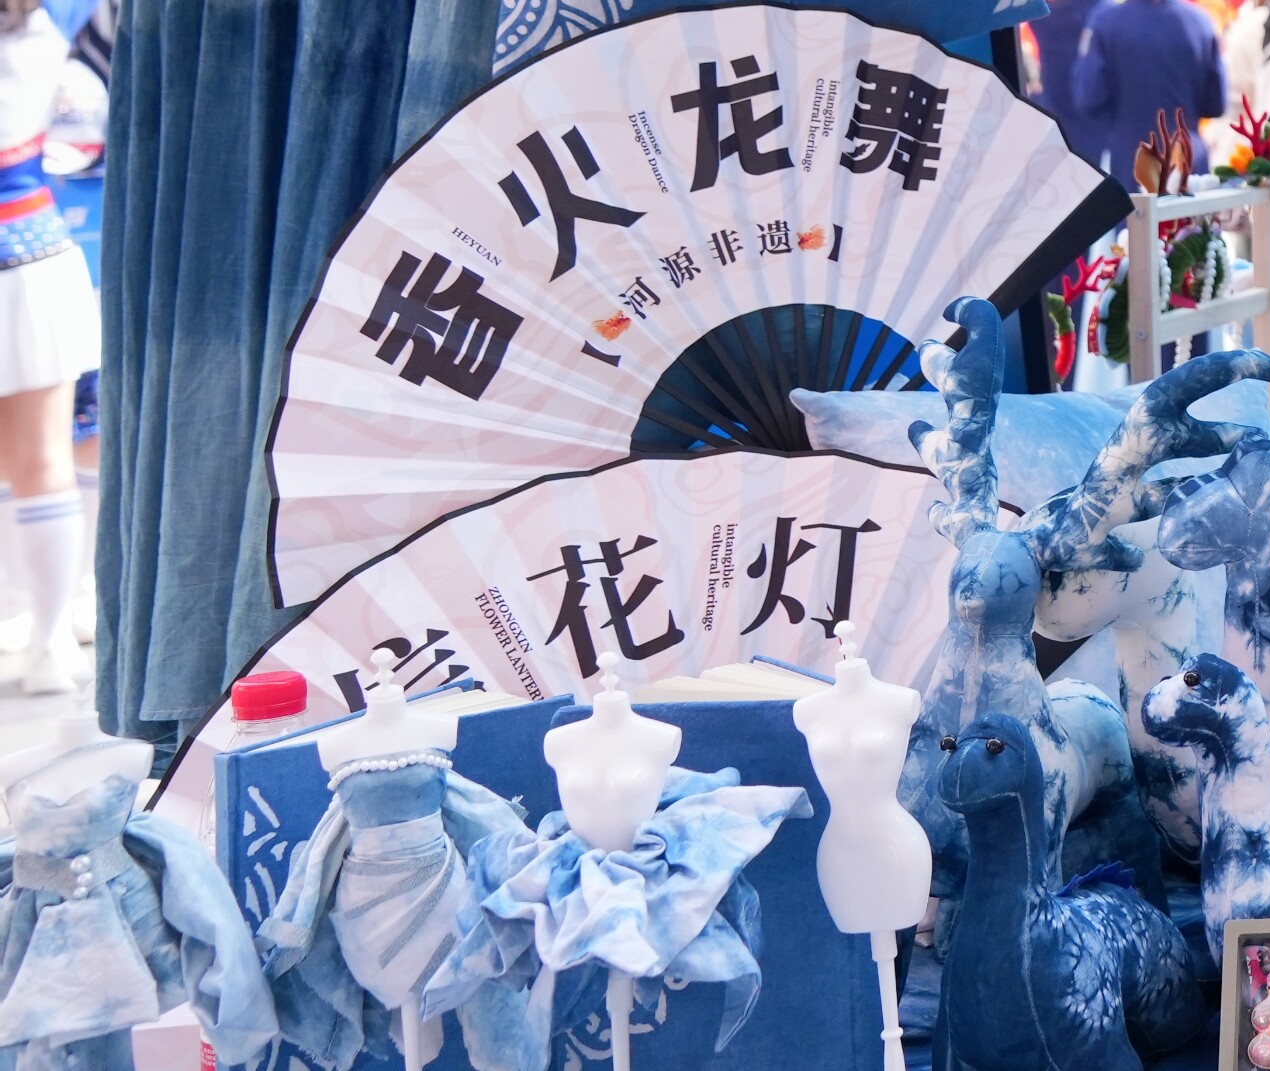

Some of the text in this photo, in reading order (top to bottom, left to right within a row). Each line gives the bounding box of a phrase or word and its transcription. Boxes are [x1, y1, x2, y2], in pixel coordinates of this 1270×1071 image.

[637, 110, 662, 156] Incense
[802, 78, 825, 174] cultural heritage
[822, 79, 841, 138] intangible
[628, 114, 669, 195] Dragon Dance
[359, 54, 949, 402] 香火龙舞
[452, 227, 503, 267] HEYUAN
[702, 524, 721, 631] cultural heritage
[721, 523, 738, 589] intangible
[475, 592, 511, 649] FLOWER
[488, 586, 533, 654] ZHONGXIN
